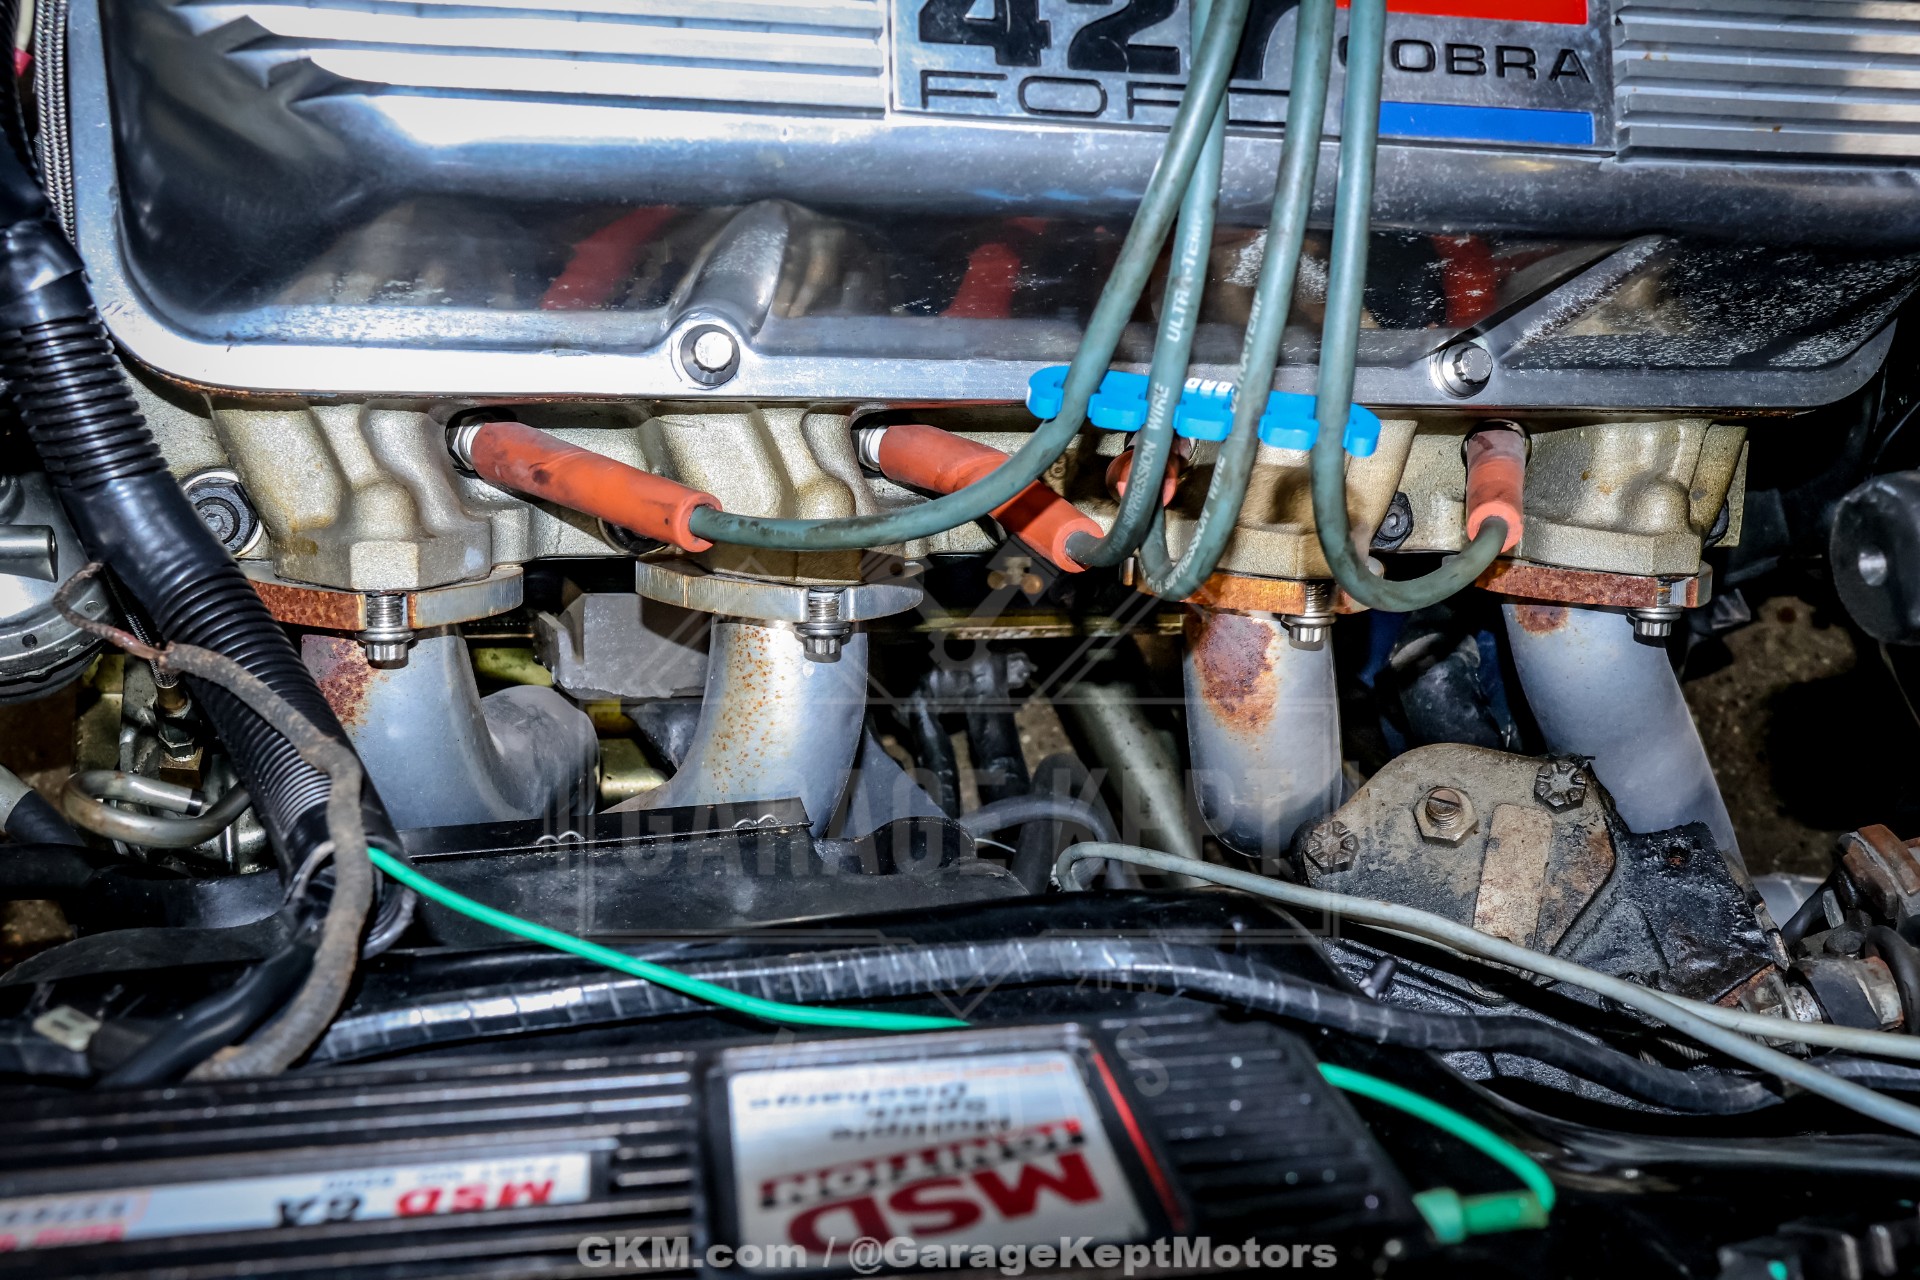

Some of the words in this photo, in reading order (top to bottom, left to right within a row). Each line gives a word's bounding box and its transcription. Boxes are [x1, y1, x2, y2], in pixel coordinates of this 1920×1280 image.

[1123, 440, 1157, 526] SUPPRESSION
[1147, 382, 1171, 431] WIRE
[1165, 212, 1204, 343] ULTRA-TEMP
[394, 1181, 554, 1218] MSD
[764, 1124, 1083, 1207] IGNITION
[787, 1153, 1102, 1257] MSD
